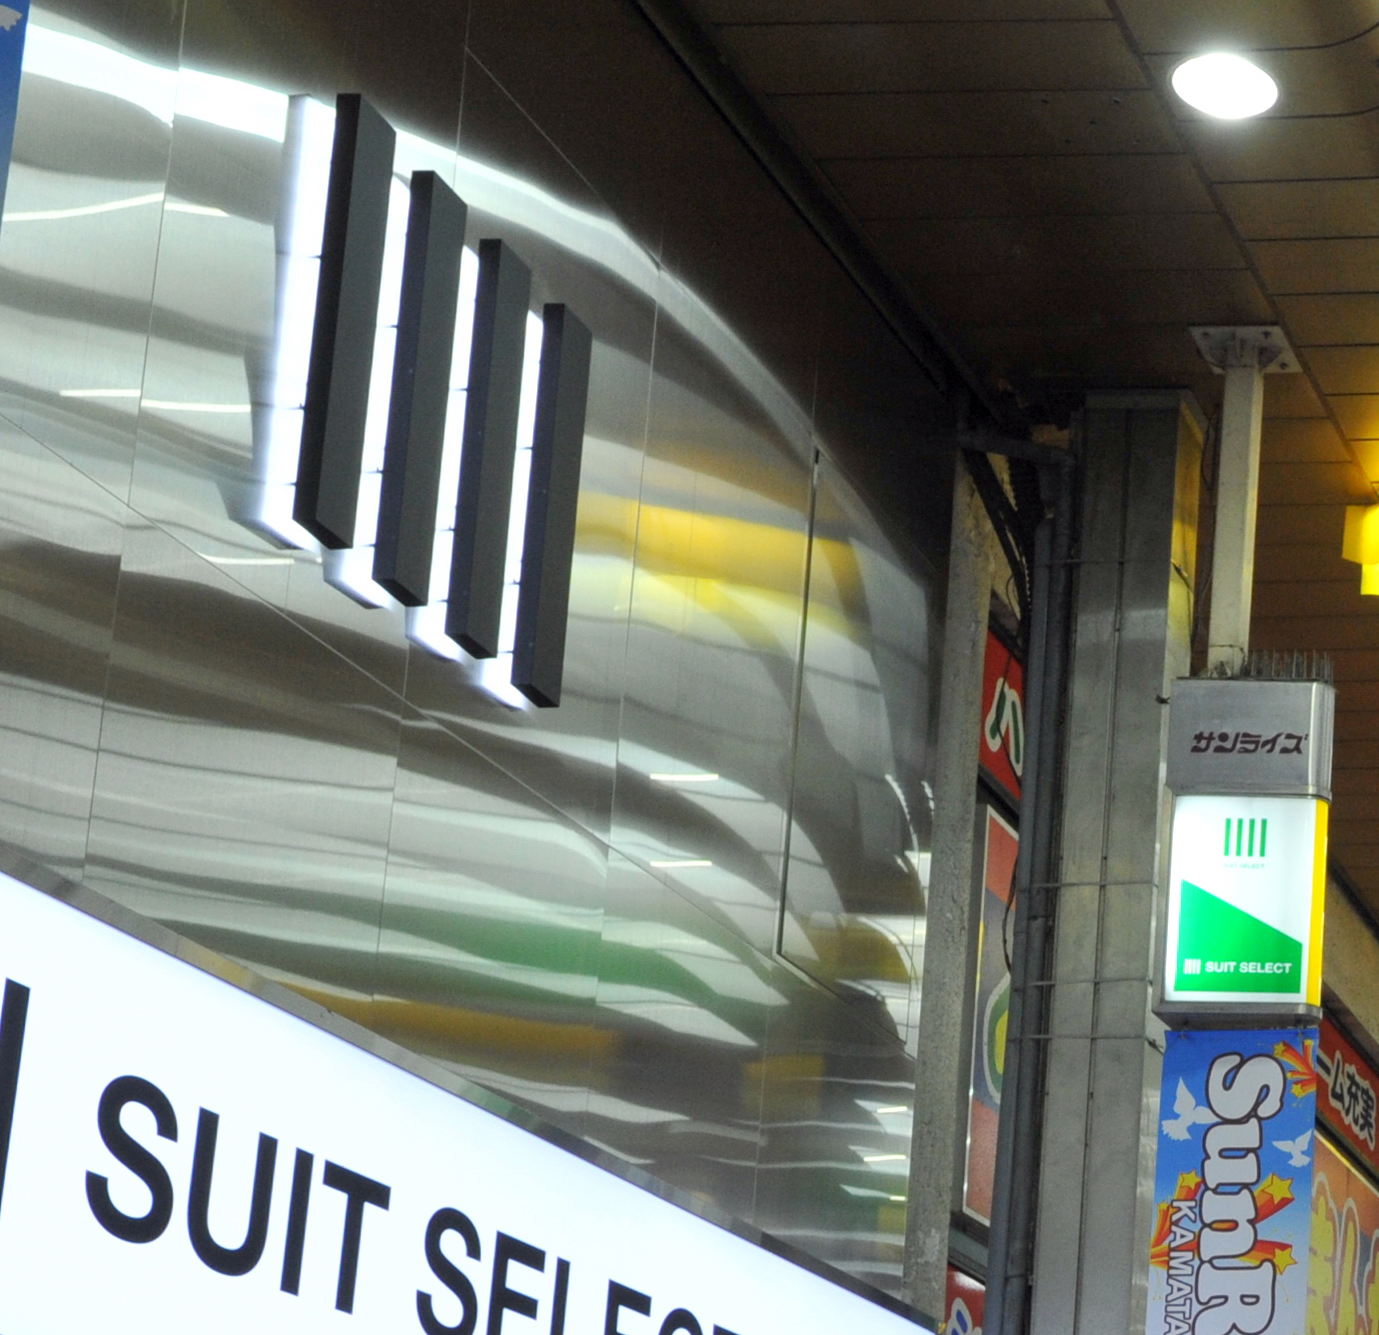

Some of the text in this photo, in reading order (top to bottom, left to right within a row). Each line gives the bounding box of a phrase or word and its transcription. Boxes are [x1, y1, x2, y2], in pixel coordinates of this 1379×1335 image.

[1190, 730, 1309, 755] サンライズ
[1204, 960, 1293, 975] SUIT SELECT
[84, 1072, 393, 1316] SUIT
